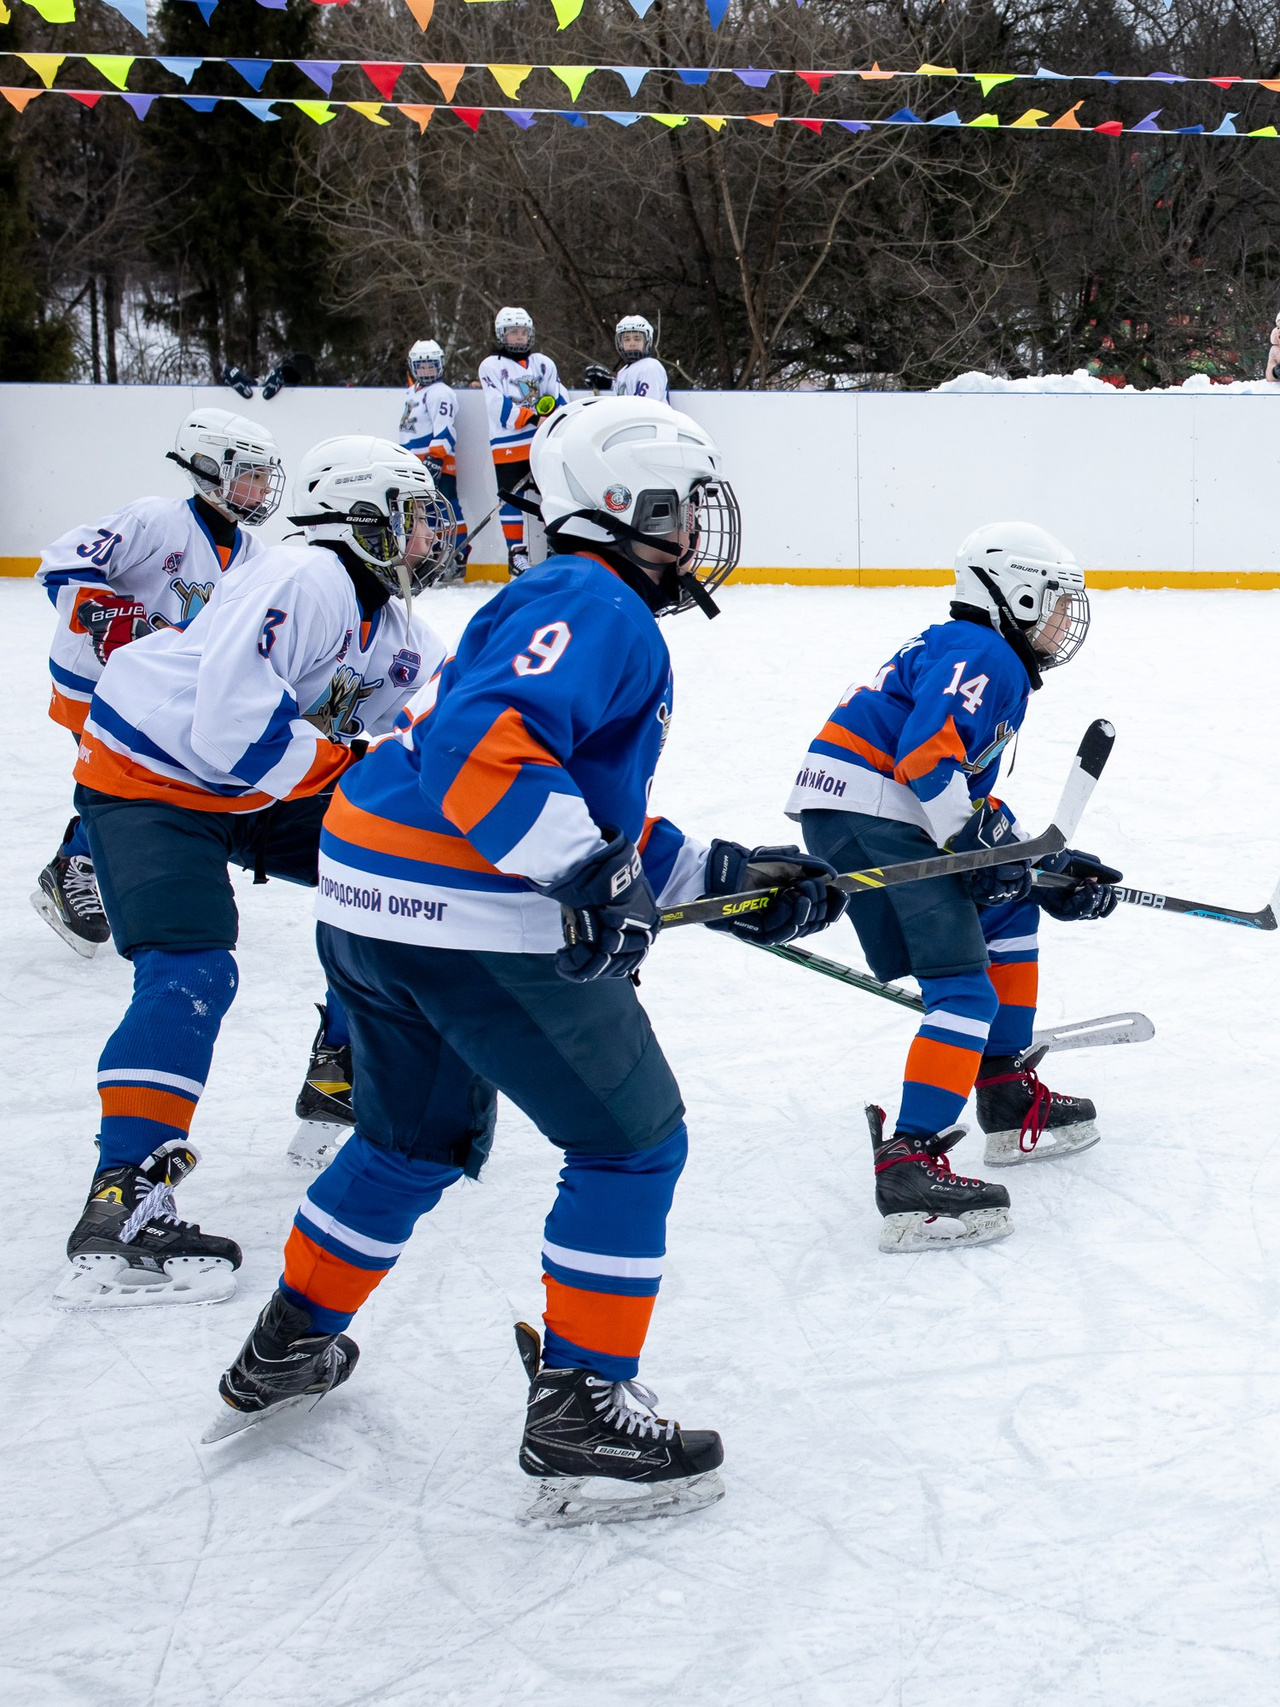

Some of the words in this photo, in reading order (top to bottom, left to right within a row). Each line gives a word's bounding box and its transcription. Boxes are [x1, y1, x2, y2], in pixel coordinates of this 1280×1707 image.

[439, 402, 453, 418] 51
[76, 528, 123, 567] 30
[1010, 563, 1040, 574] BAUER
[91, 605, 147, 622] BAUE
[257, 608, 287, 660] 3
[511, 621, 573, 677] 9
[942, 661, 990, 715] 14
[721, 855, 729, 883] BAUER
[321, 876, 382, 912] ГОРОДСКОЙ
[388, 895, 448, 921] ОКРУГ
[722, 896, 770, 916] SUPER
[1114, 887, 1167, 909] AUER
[598, 1447, 637, 1458] BAUER
